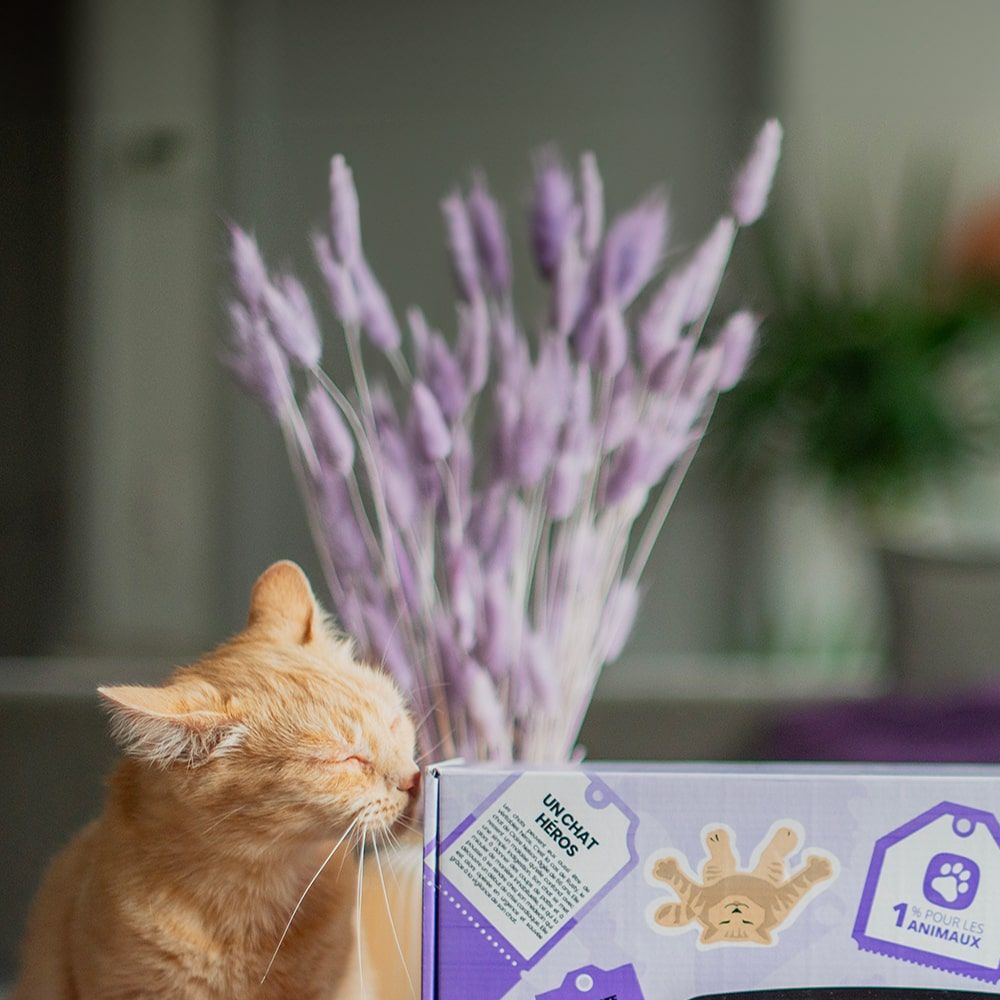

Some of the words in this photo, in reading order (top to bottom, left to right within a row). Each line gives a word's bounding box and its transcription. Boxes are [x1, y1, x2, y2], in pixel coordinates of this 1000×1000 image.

[534, 809, 582, 859] HÉROS
[541, 792, 566, 817] UN
[559, 810, 599, 852] CHAT
[906, 919, 982, 948] ANIMAUX
[924, 909, 960, 927] POUR
[962, 919, 985, 934] LES
